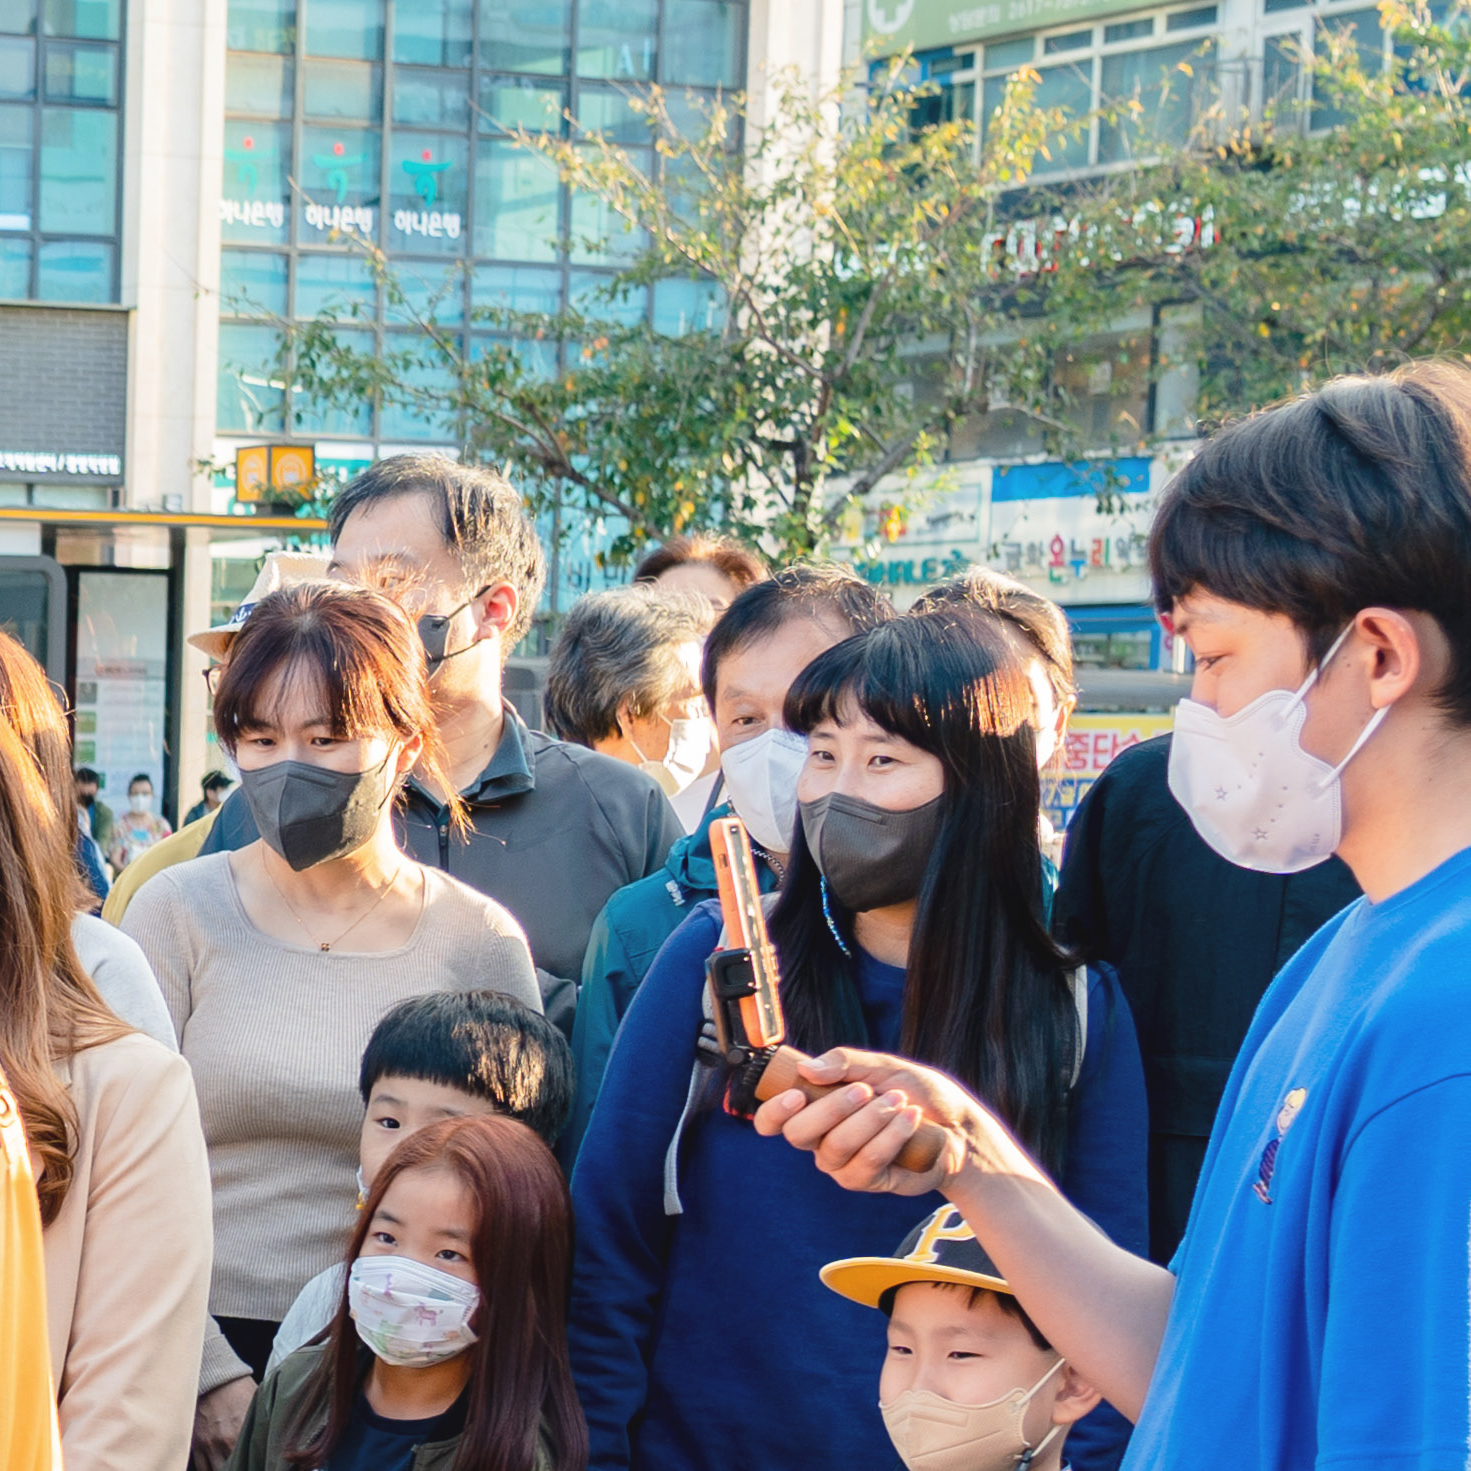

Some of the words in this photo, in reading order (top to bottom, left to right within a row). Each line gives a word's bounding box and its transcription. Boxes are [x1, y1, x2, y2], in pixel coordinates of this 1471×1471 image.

[305, 203, 374, 233] 하나은행
[394, 208, 461, 239] 하나은행
[904, 1203, 977, 1263] P
